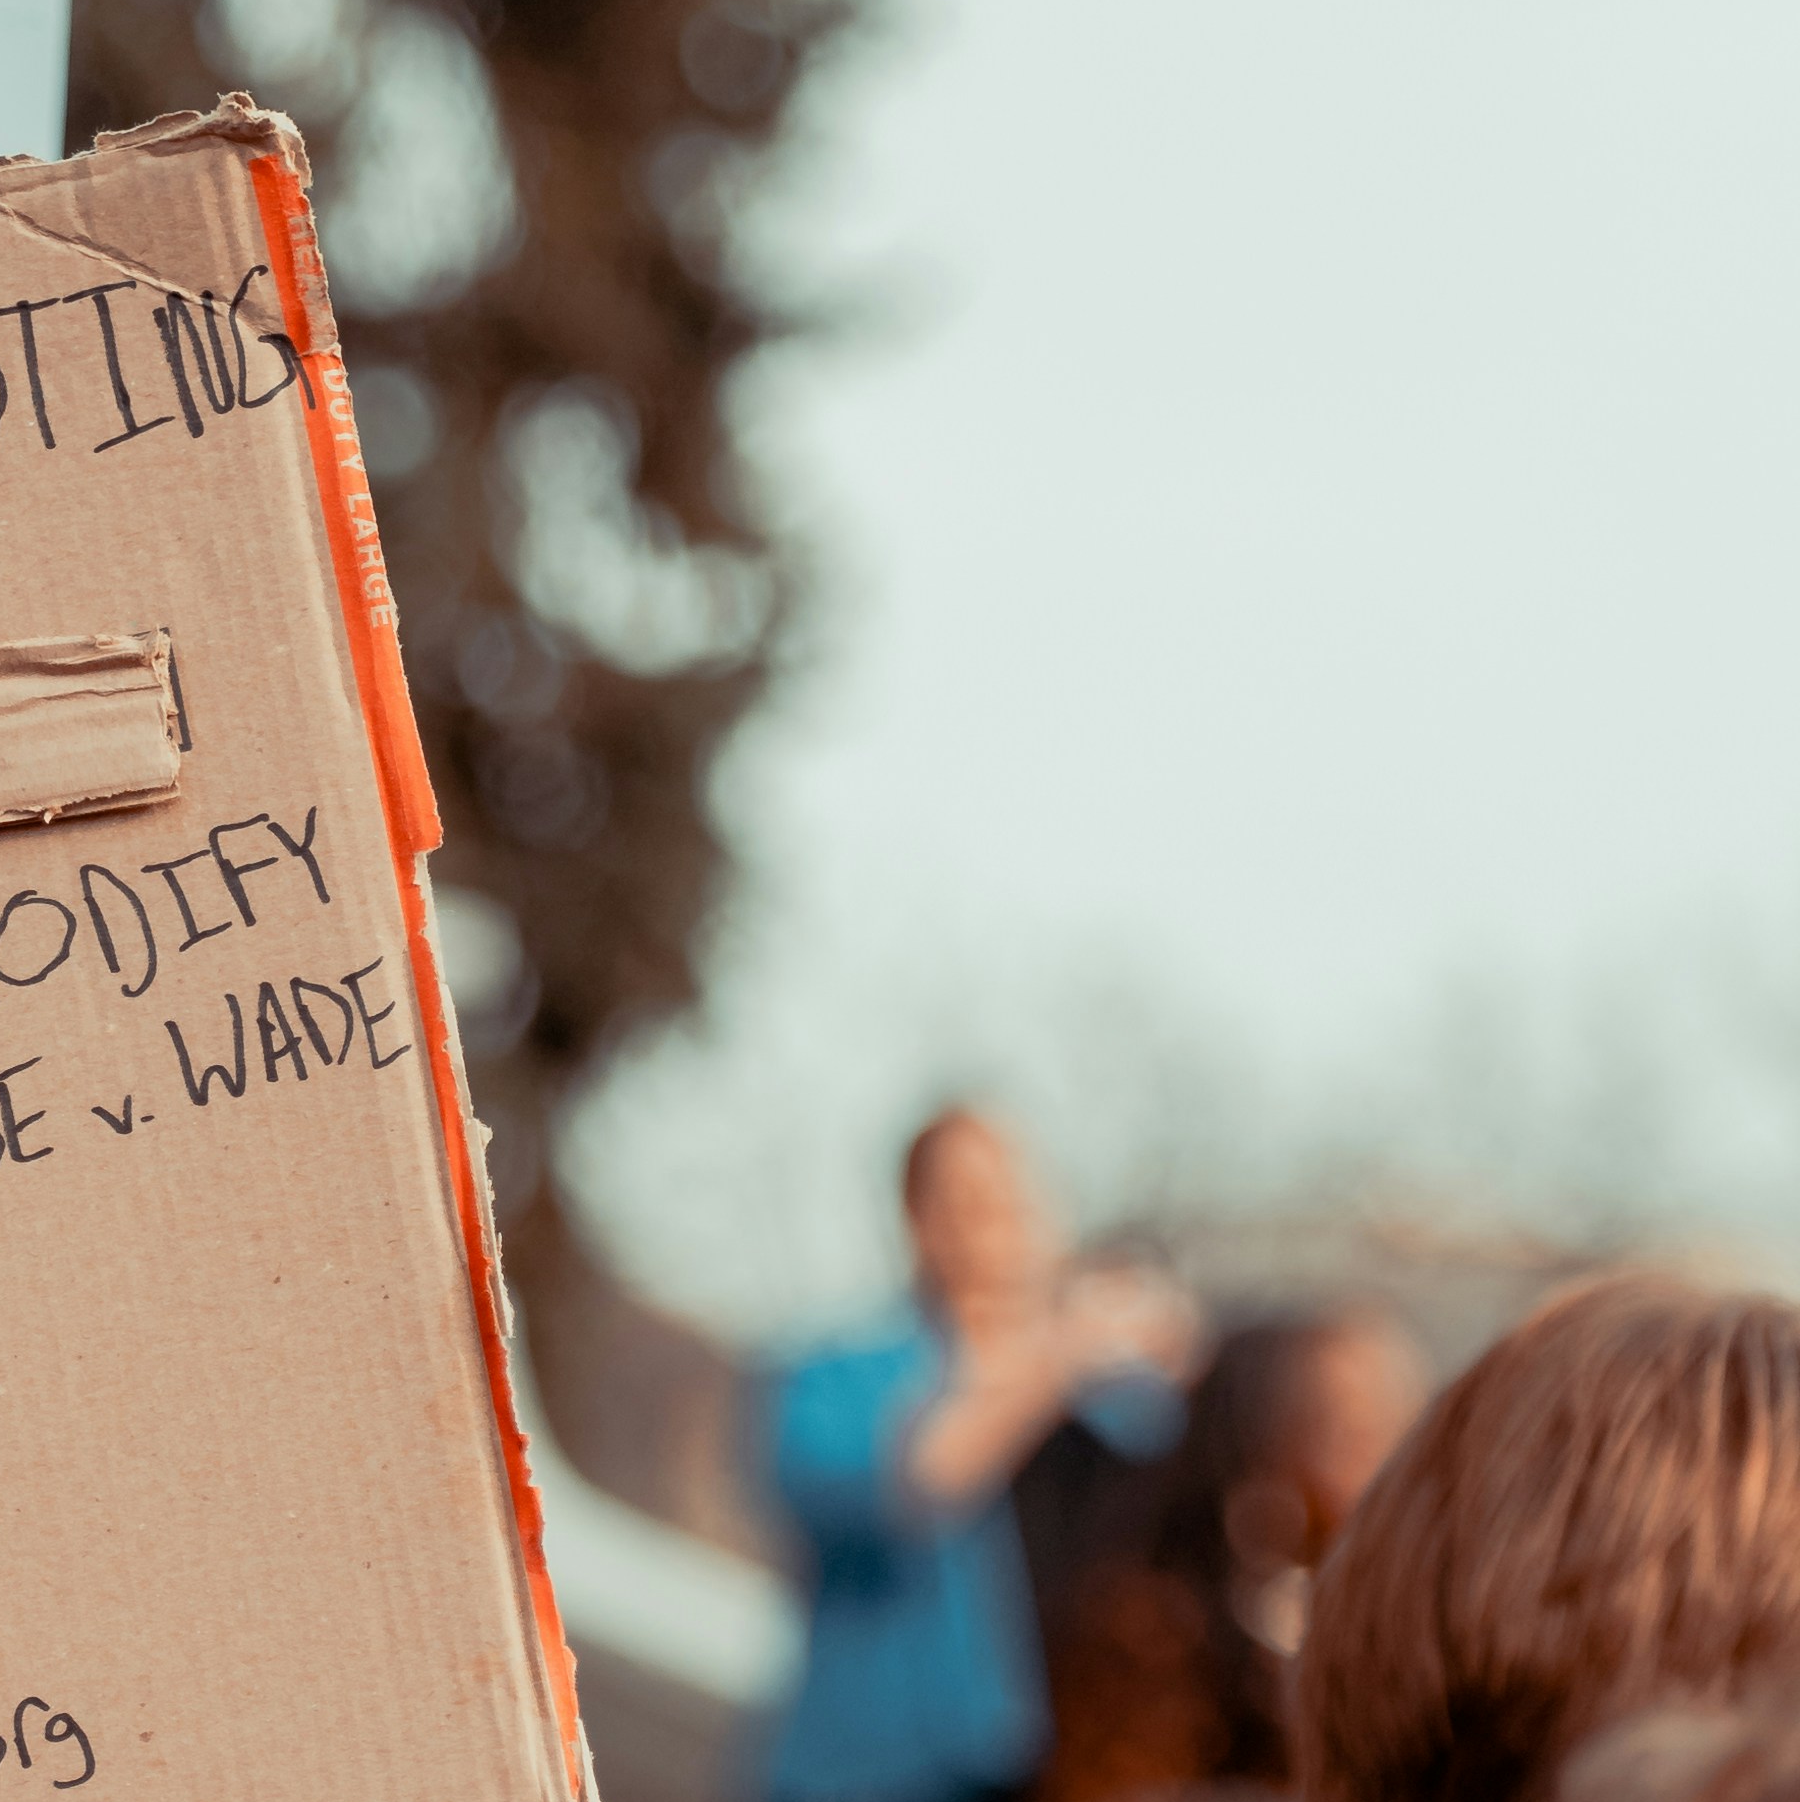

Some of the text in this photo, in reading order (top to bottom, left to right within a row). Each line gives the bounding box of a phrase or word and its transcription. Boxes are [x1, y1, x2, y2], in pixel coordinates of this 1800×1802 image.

[320, 368, 367, 474] DUTY
[346, 492, 393, 629] LARGE
[166, 955, 412, 1107] WADE
